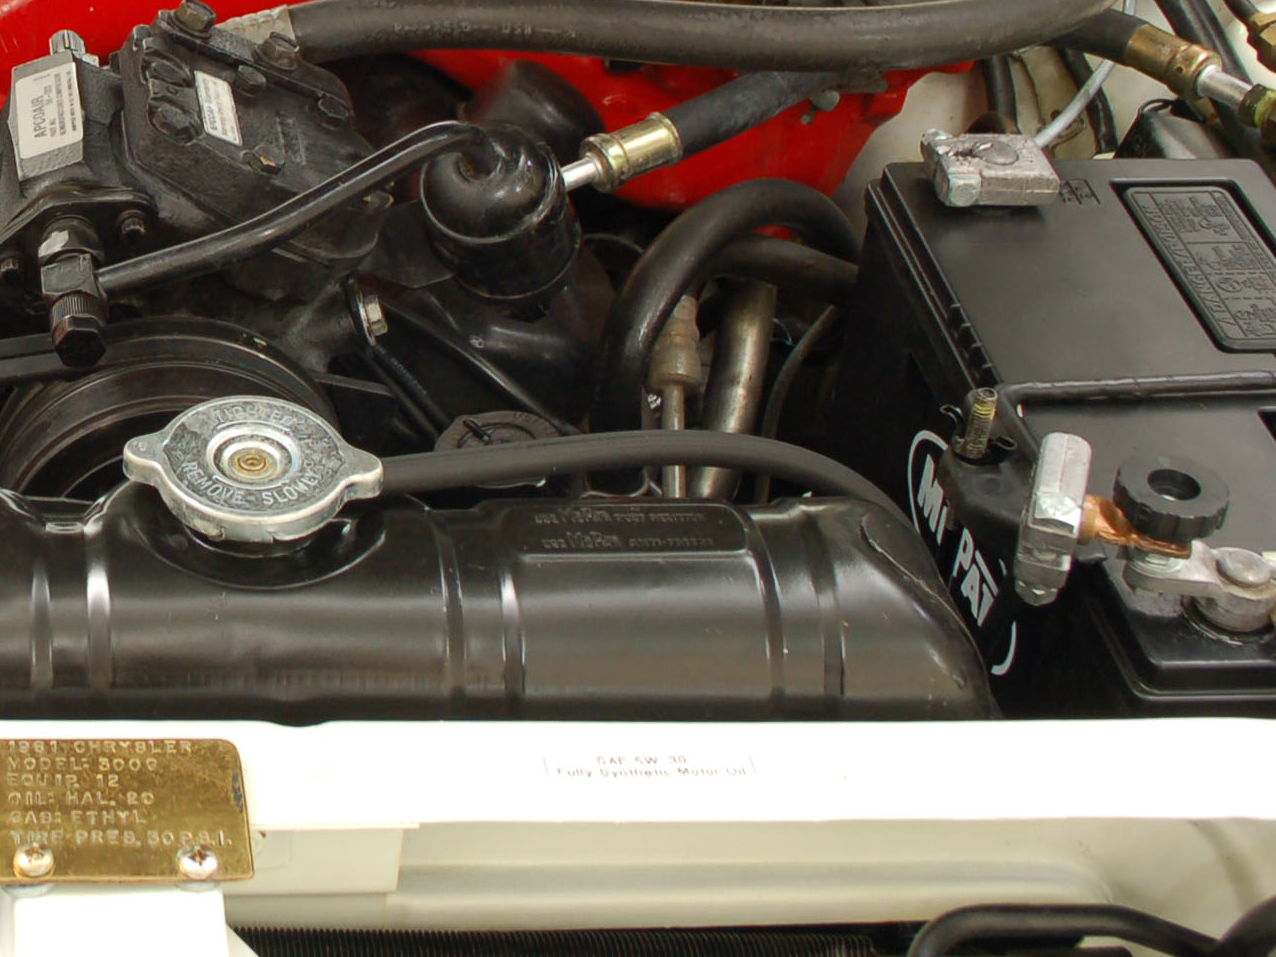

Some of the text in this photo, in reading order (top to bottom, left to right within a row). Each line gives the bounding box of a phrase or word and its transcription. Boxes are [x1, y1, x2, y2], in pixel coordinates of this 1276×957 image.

[30, 94, 48, 139] APCOAIR
[181, 459, 325, 506] REMOVE SLOWLY
[73, 739, 192, 754] CHRYSLER
[95, 773, 120, 788] 12
[125, 791, 156, 806] 20
[69, 809, 148, 826] ETHYL
